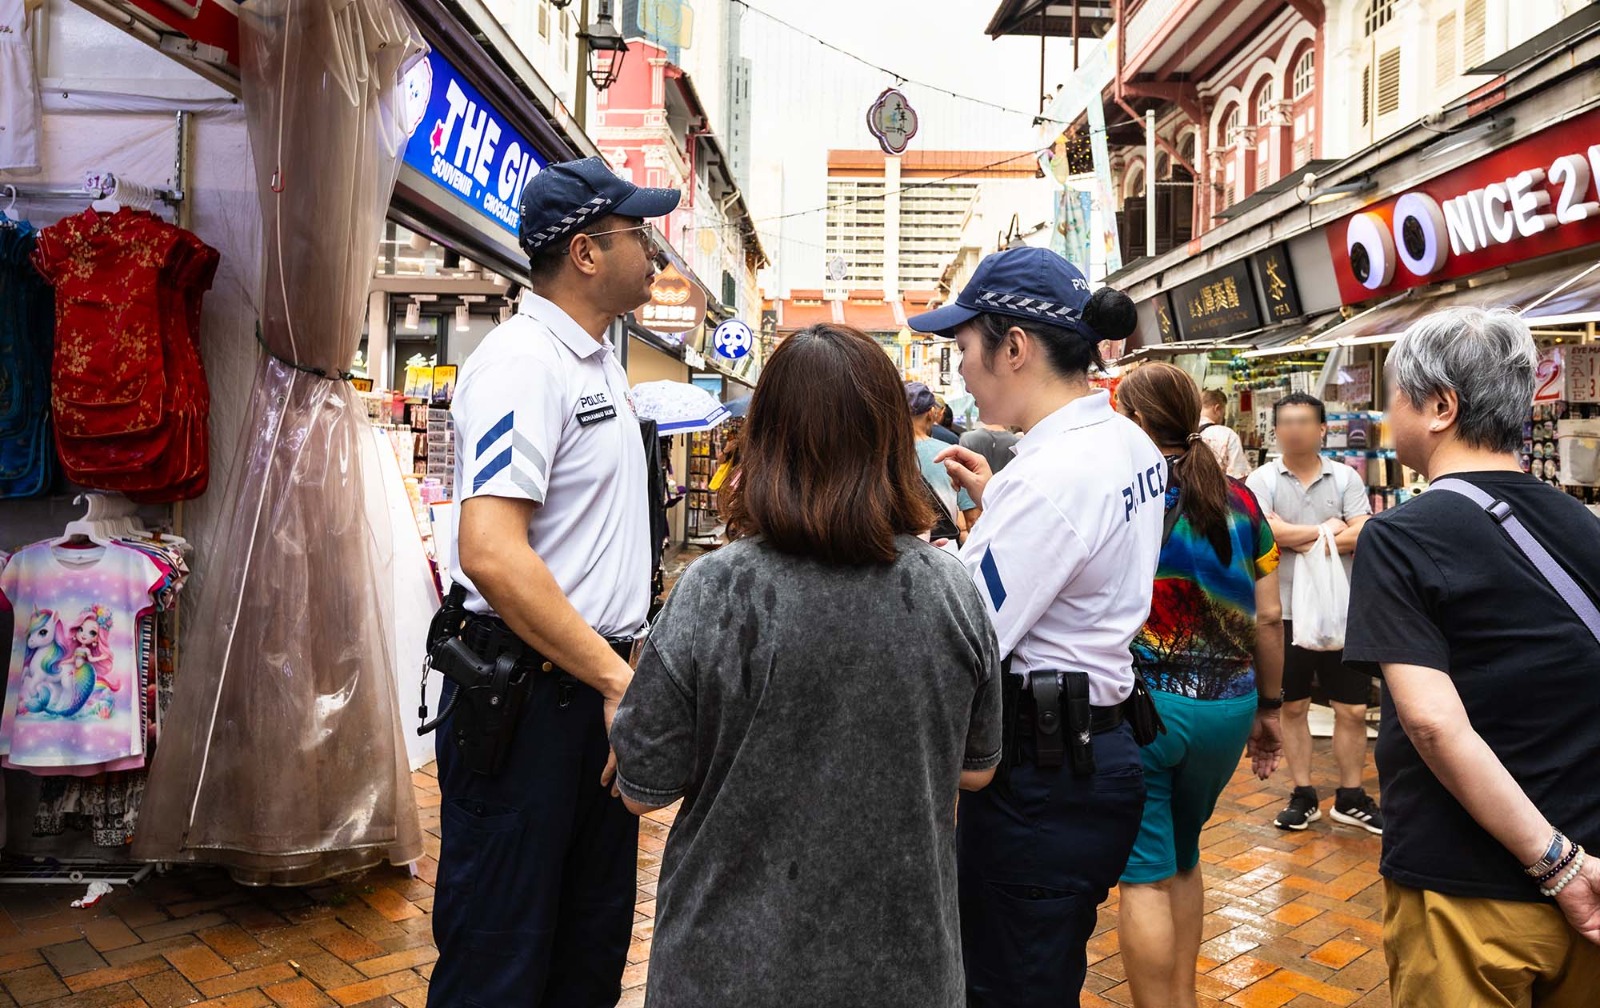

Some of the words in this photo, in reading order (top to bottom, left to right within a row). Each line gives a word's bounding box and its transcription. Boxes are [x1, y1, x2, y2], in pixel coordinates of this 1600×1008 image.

[441, 78, 502, 188] THE
[498, 141, 544, 209] GIF
[432, 155, 473, 197] SOUVENIR
[483, 192, 520, 229] CHOCOLATE
[1571, 346, 1587, 354] EYE
[579, 392, 607, 408] POLICE
[1571, 355, 1586, 401] SALE
[1122, 462, 1165, 523] PICE
